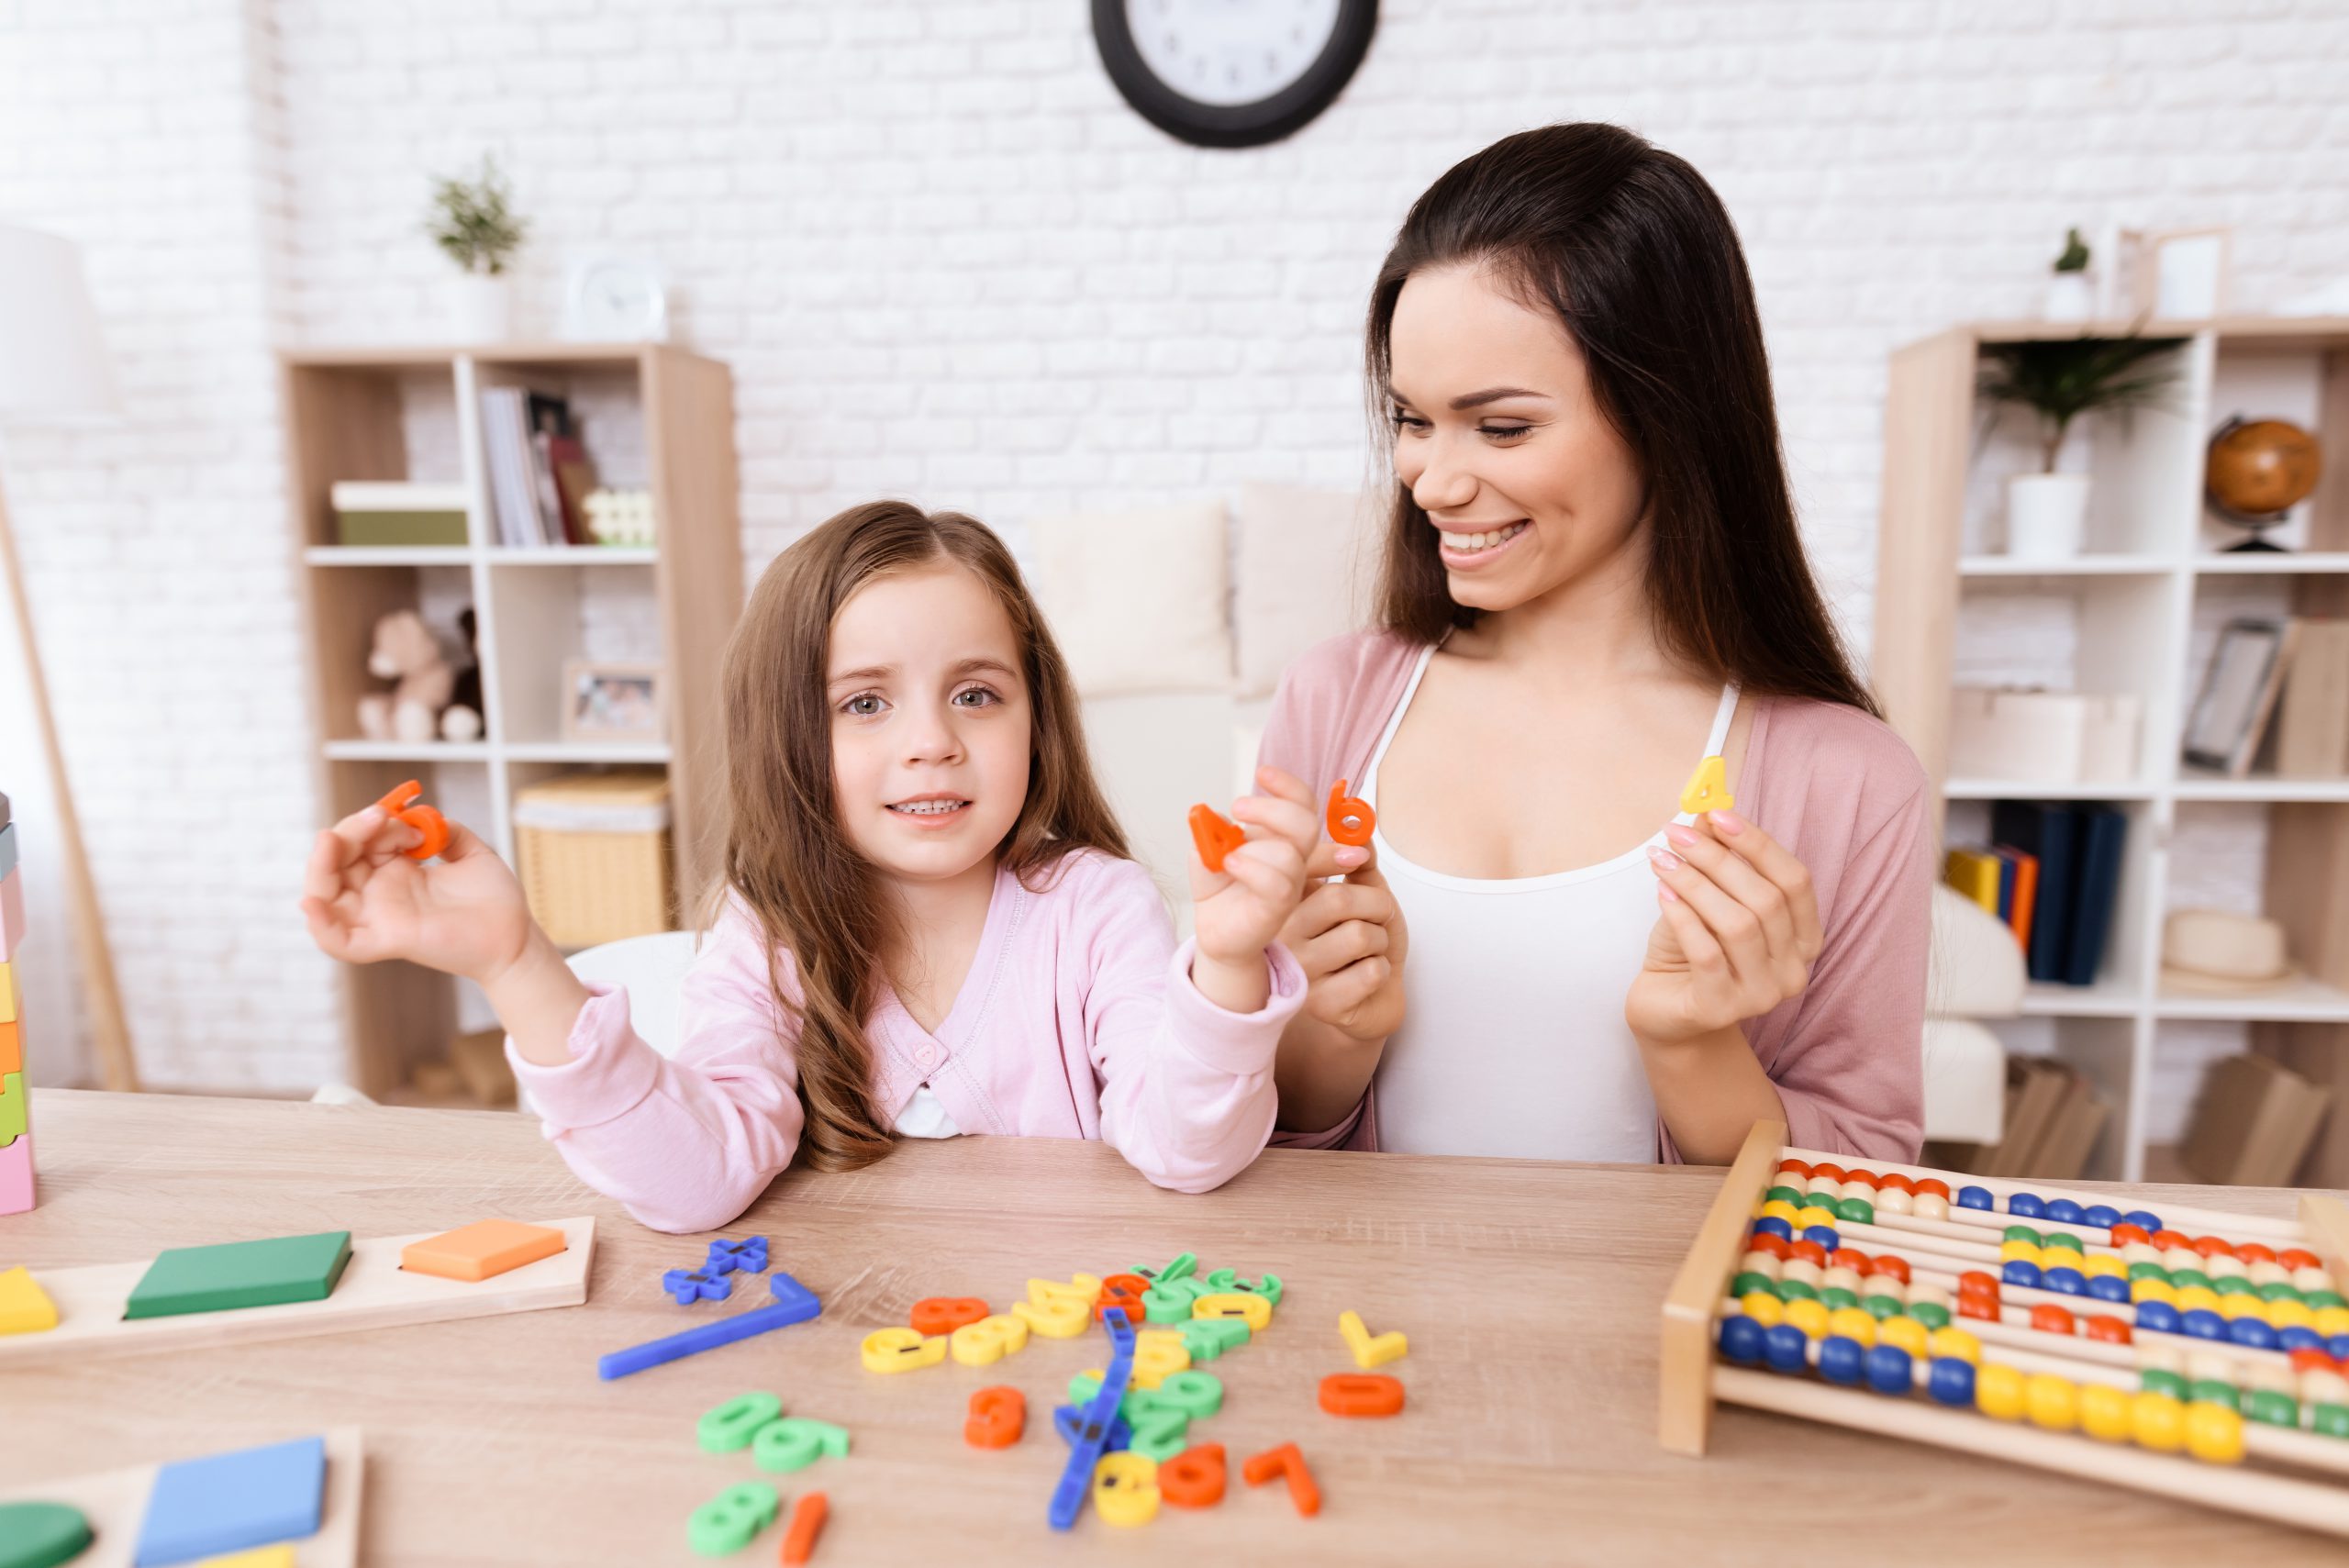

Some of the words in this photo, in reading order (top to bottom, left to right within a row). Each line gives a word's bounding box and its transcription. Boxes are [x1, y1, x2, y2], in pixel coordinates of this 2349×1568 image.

[1327, 778, 1376, 847] 6
[1680, 756, 1734, 815] 4
[950, 1314, 1029, 1367] 8
[1318, 1373, 1406, 1419] 0
[686, 1479, 780, 1560] 8
